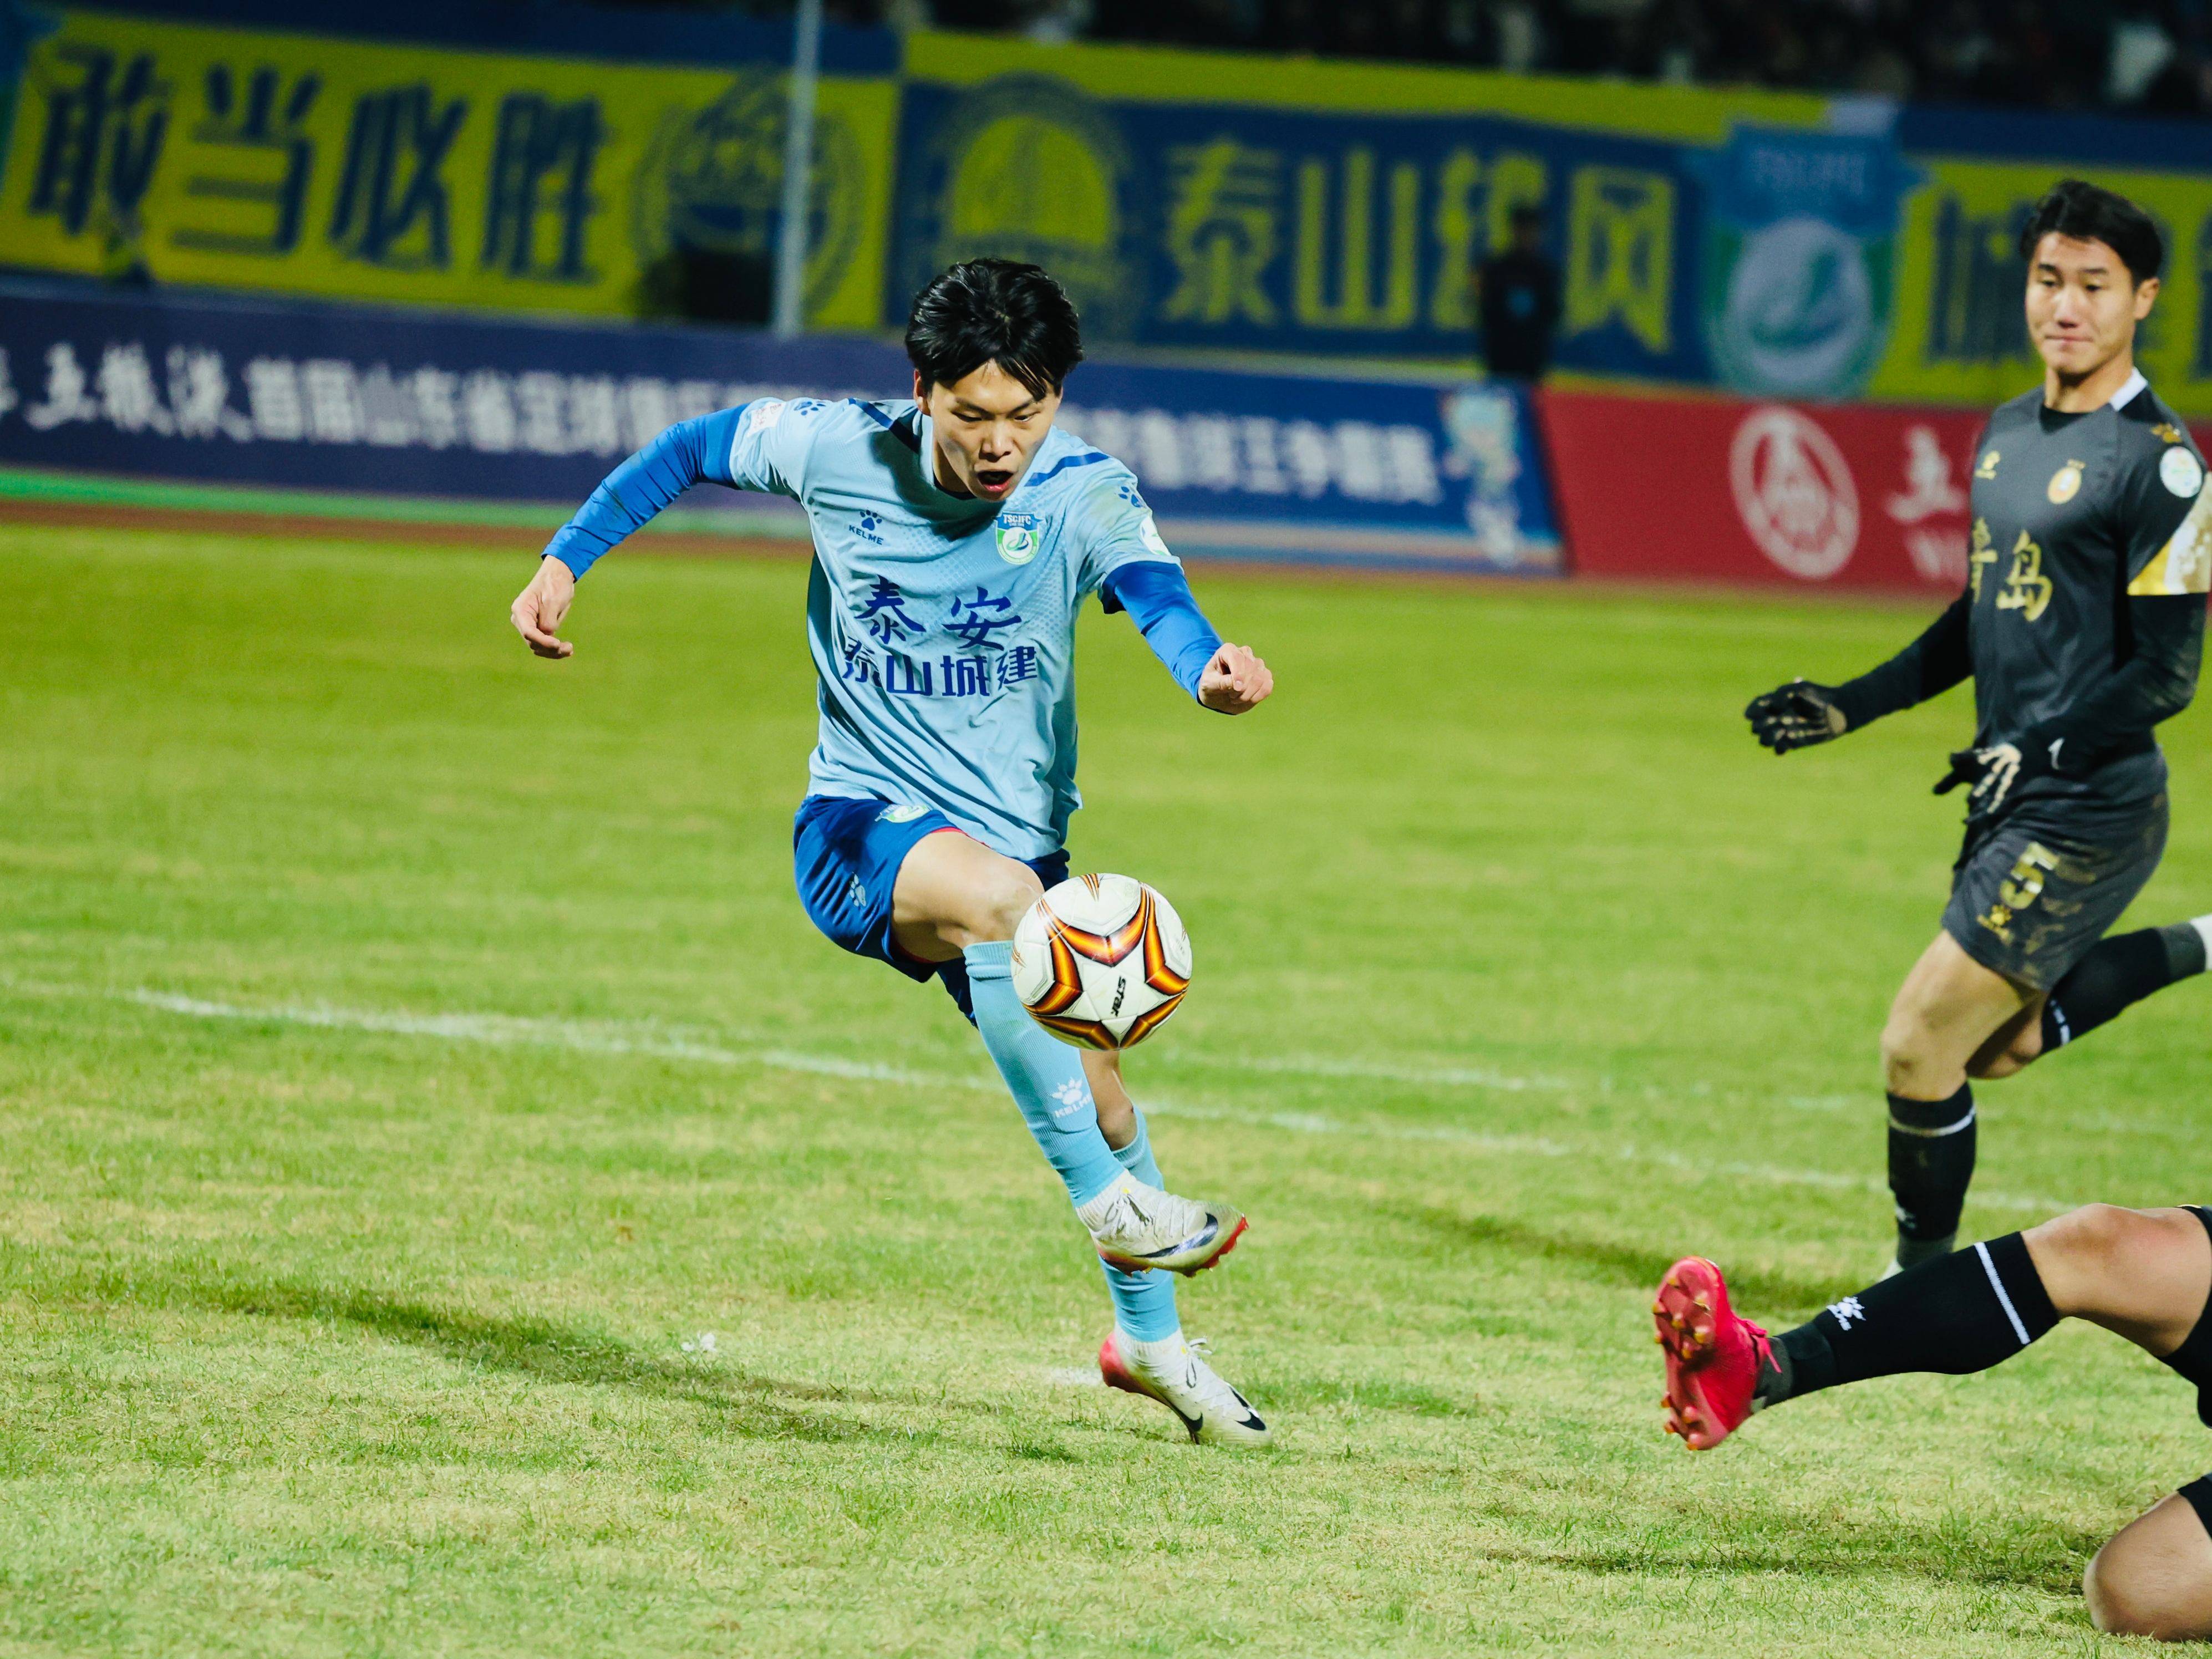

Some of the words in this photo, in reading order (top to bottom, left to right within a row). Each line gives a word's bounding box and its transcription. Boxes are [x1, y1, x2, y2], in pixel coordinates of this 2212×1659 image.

[28, 42, 617, 284] 敢当必胜
[849, 525, 884, 545] KELME
[855, 574, 1022, 651] 泰安
[842, 636, 1038, 697] 泰山城建
[2000, 841, 2059, 910] 5
